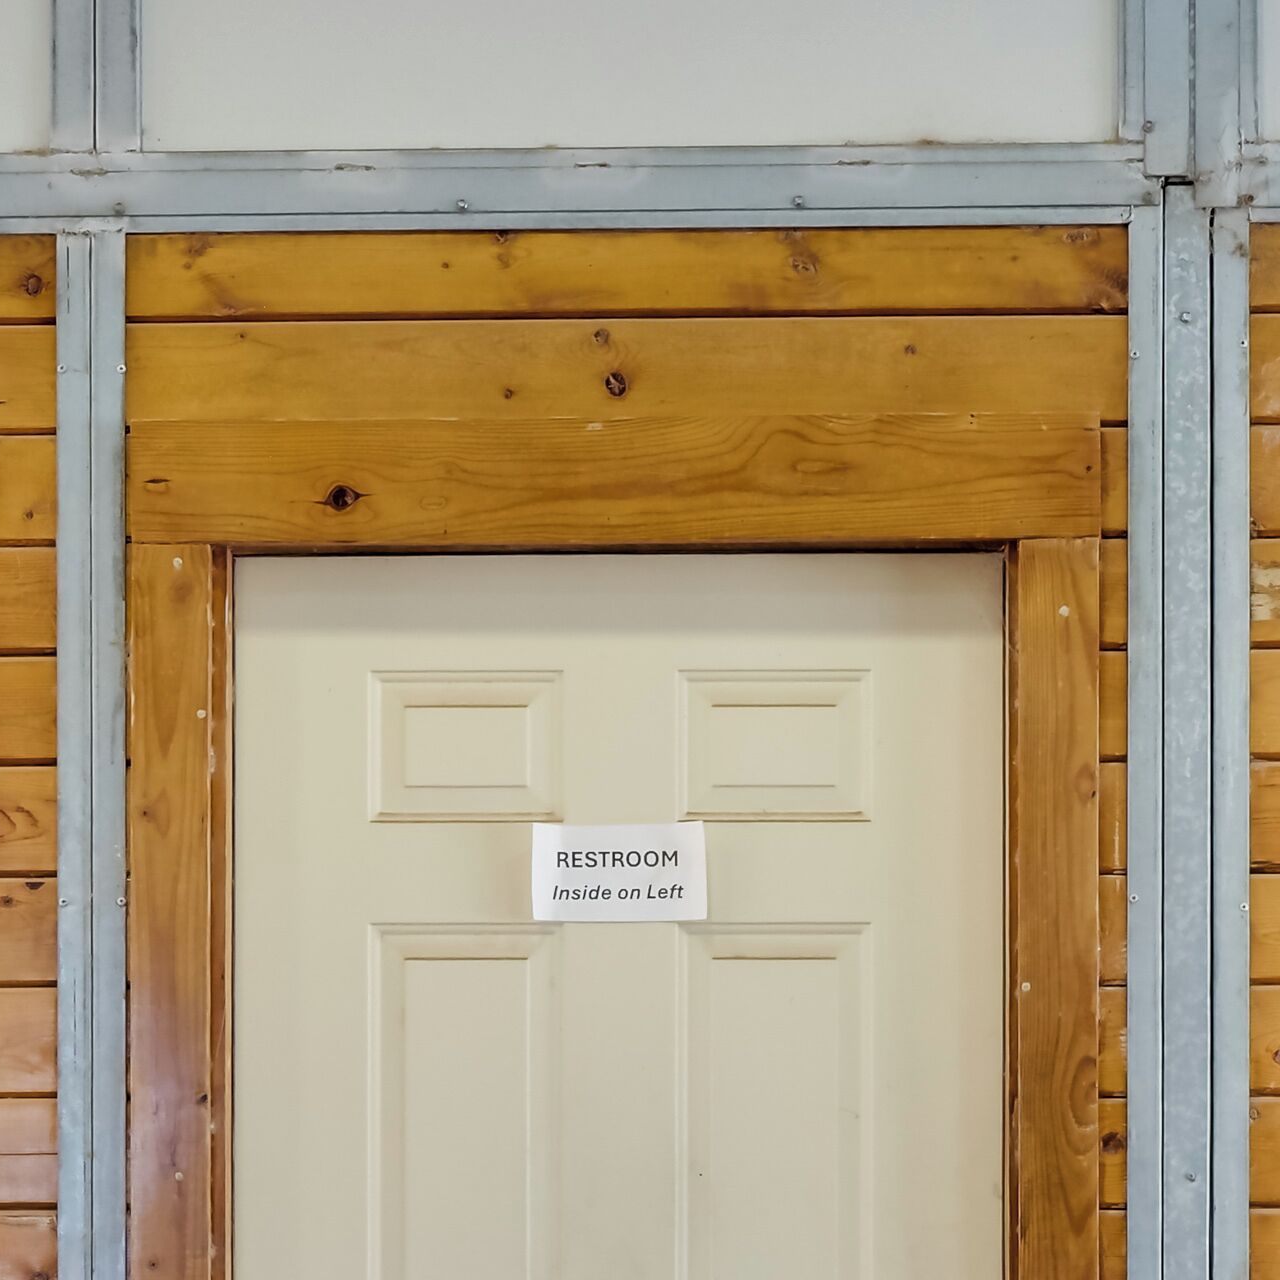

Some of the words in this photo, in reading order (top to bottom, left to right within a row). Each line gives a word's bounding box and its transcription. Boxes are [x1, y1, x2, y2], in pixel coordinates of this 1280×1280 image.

[556, 850, 679, 868] RESTROOM
[552, 884, 612, 901] Inside
[617, 887, 641, 900] on
[647, 883, 684, 899] Left
